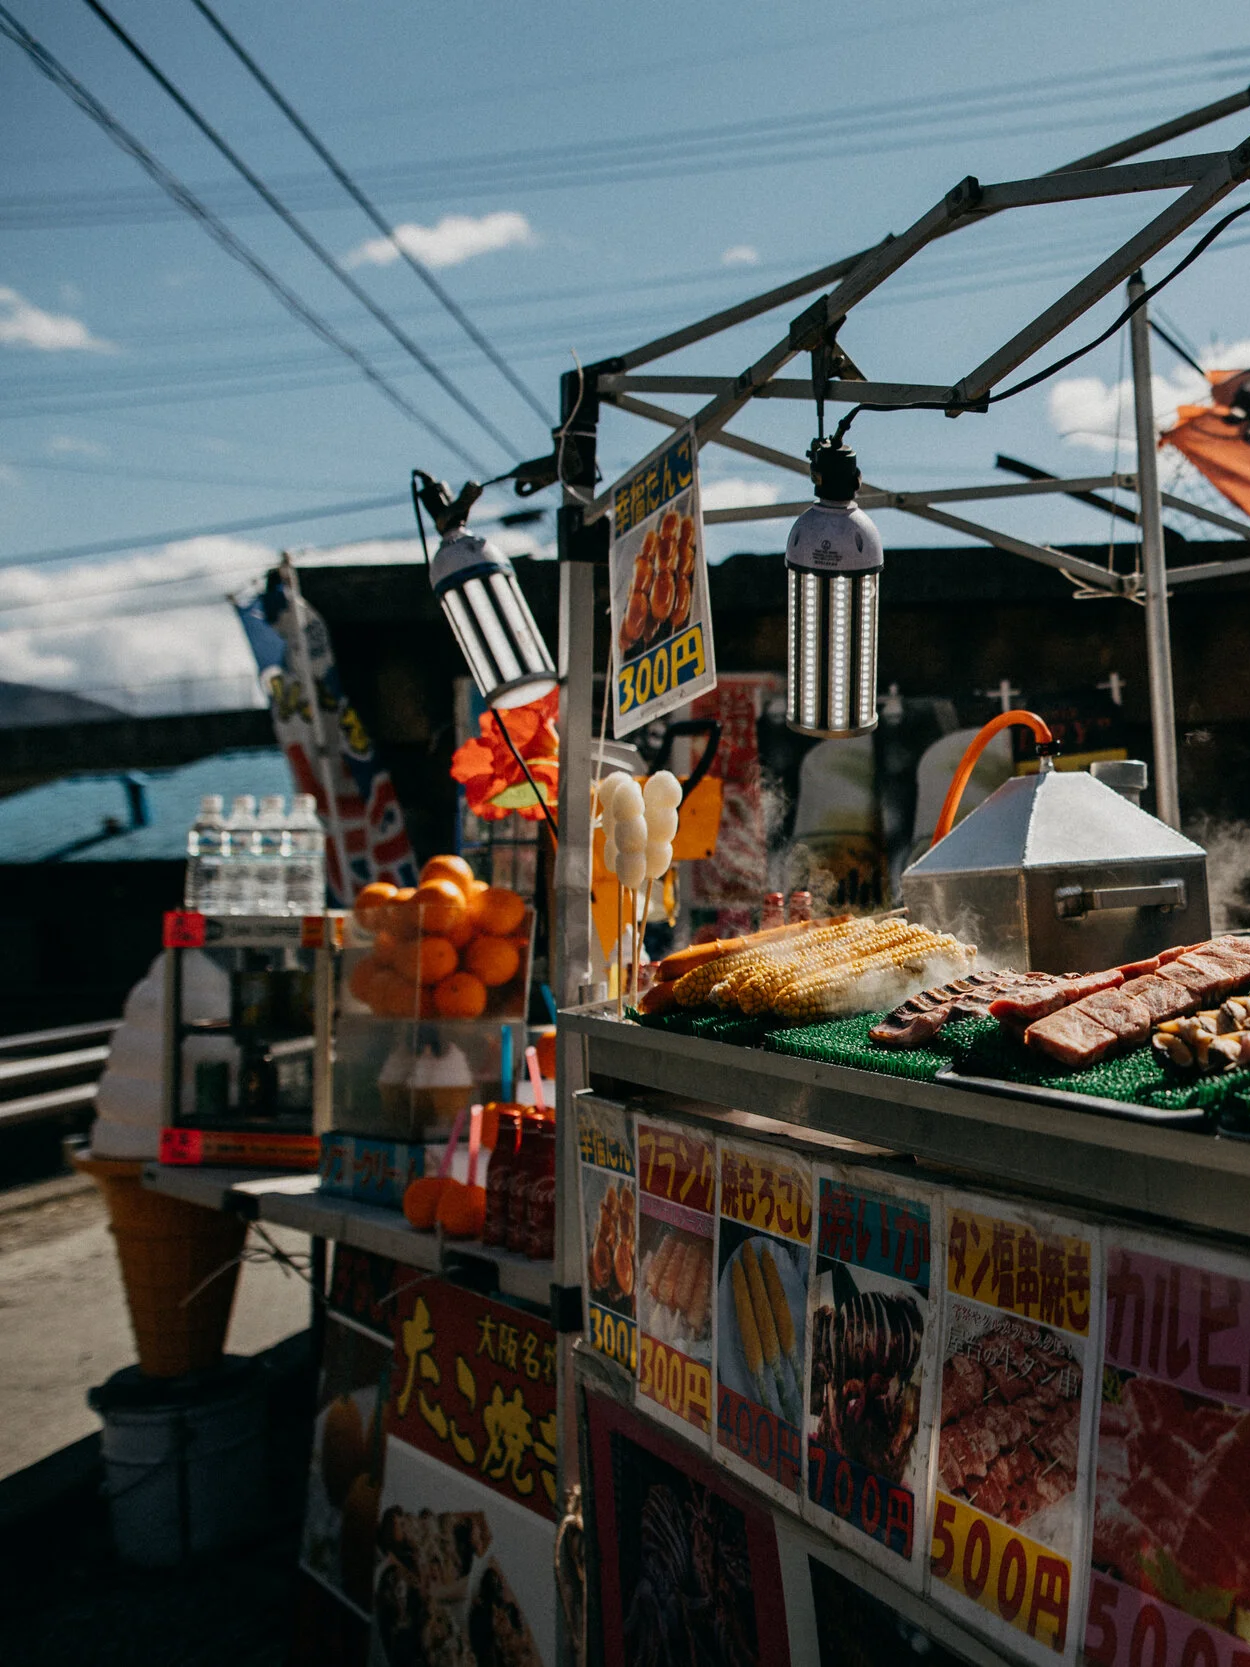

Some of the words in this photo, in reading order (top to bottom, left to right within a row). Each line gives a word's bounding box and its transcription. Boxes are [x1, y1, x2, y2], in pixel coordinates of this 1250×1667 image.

[618, 625, 705, 714] 300円
[639, 1132, 715, 1212] フランク
[721, 1150, 811, 1238] 焼もろこし
[819, 1180, 931, 1280] 焼いか
[949, 1217, 1090, 1331] タン塩串焼き
[590, 1307, 636, 1370] 300
[640, 1337, 712, 1433] 300円
[718, 1393, 802, 1494] 400円
[809, 1446, 914, 1558] 700円
[931, 1501, 1070, 1653] 500円
